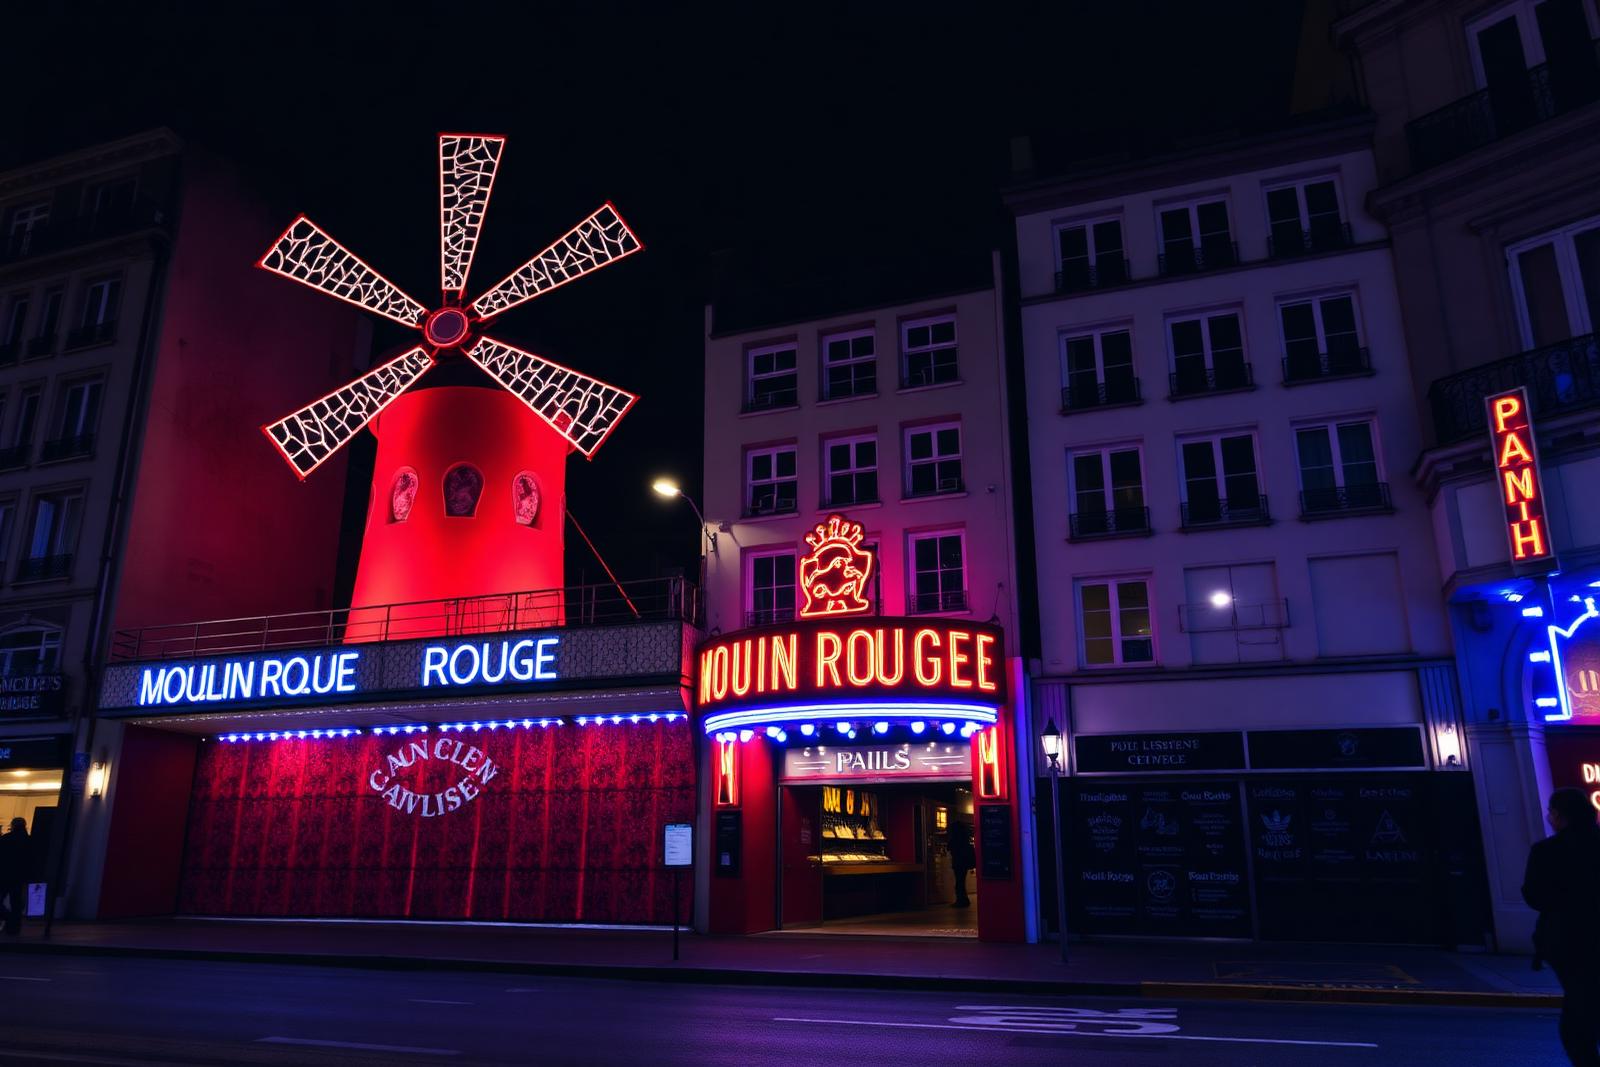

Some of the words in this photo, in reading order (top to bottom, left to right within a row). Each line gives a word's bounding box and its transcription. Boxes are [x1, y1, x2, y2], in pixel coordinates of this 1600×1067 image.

[140, 661, 254, 705] MOULIN
[423, 638, 559, 687] ROUGE
[817, 629, 996, 690] ROUGEE
